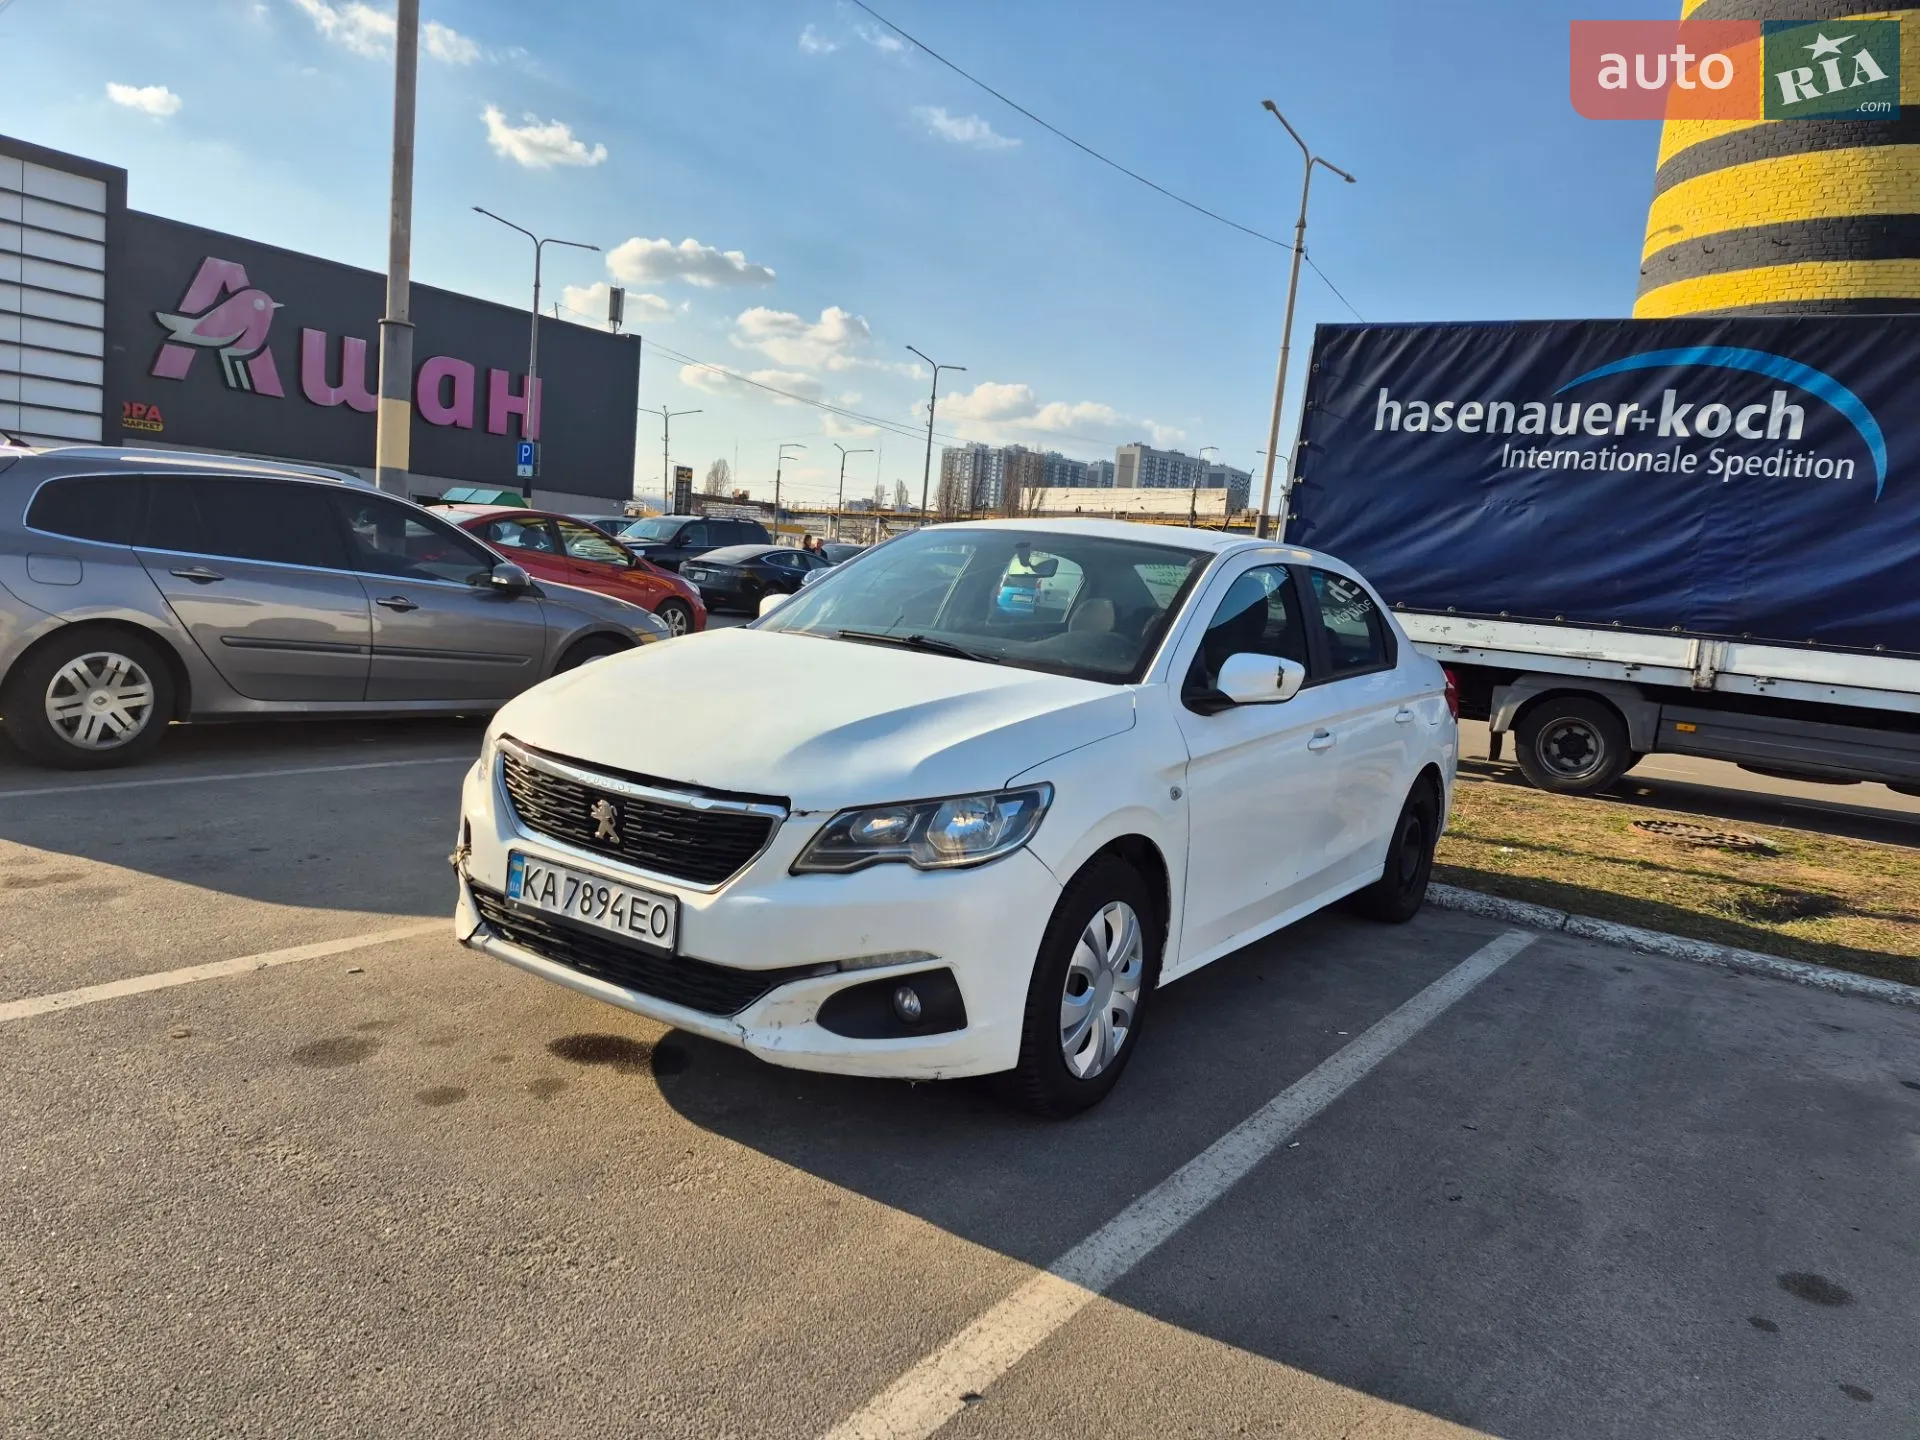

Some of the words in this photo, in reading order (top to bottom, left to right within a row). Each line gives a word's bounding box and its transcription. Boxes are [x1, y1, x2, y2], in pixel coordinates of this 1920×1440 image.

[521, 444, 531, 463] P
[1501, 443, 1698, 474] Internationale
[1706, 447, 1856, 483] Spedition
[509, 881, 520, 894] UA
